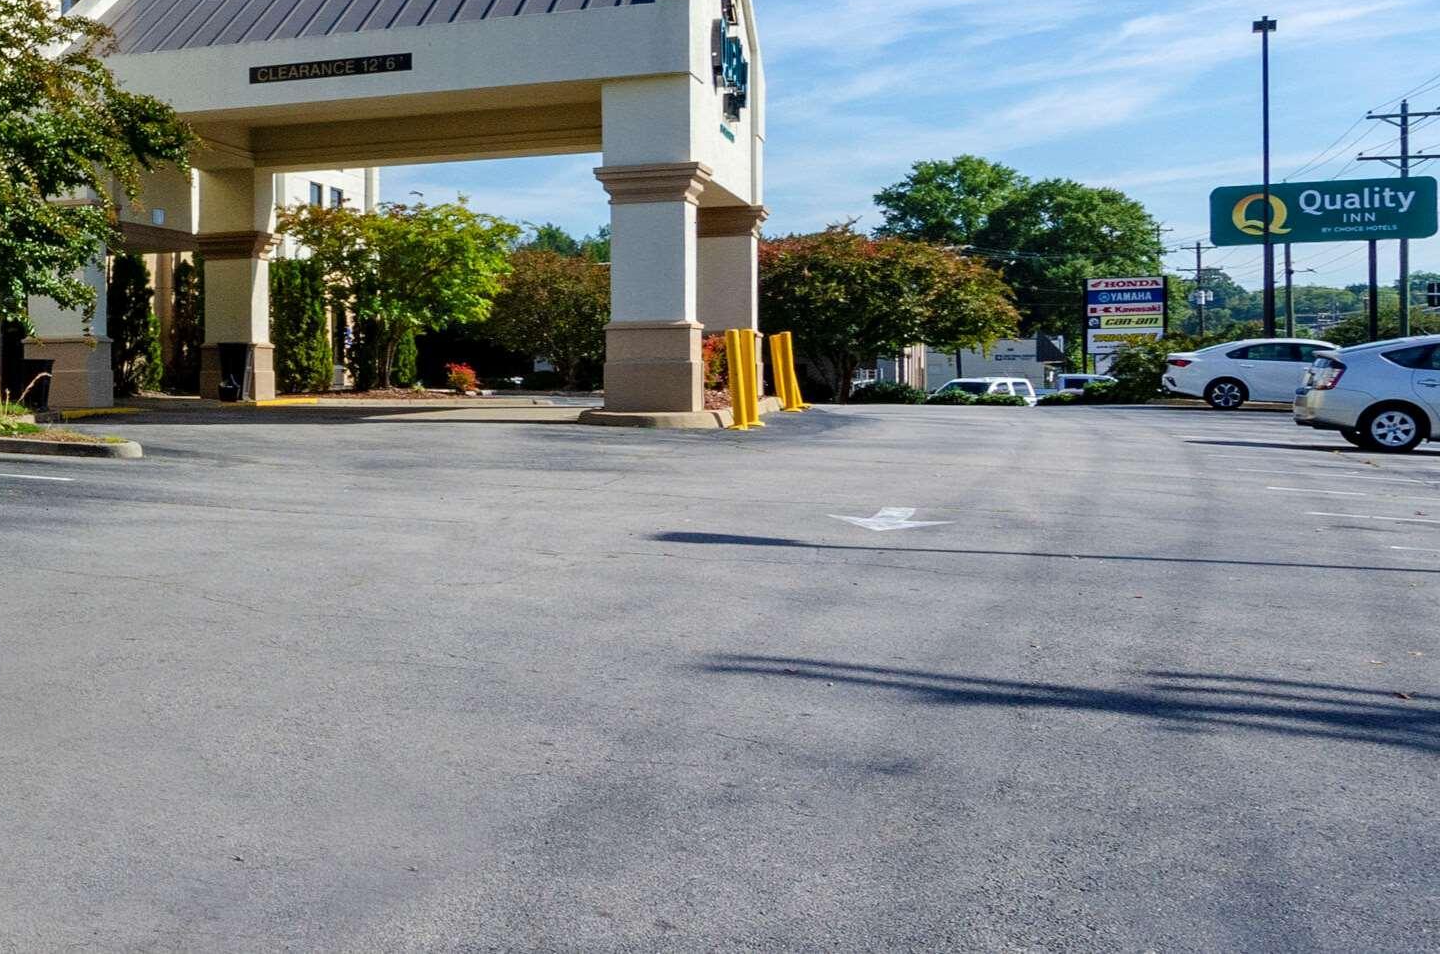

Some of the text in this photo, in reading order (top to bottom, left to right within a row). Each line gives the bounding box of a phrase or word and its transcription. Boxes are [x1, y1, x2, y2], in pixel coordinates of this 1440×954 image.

[257, 60, 355, 82] CLEARANCE
[1298, 186, 1416, 215] Quality
[1342, 211, 1377, 223] INN
[1334, 225, 1364, 233] CHOICE
[1366, 224, 1398, 232] HOTELS
[1104, 280, 1160, 288] HONDA
[1111, 292, 1152, 302] YAMAHA
[1115, 305, 1160, 314] Kawasaki
